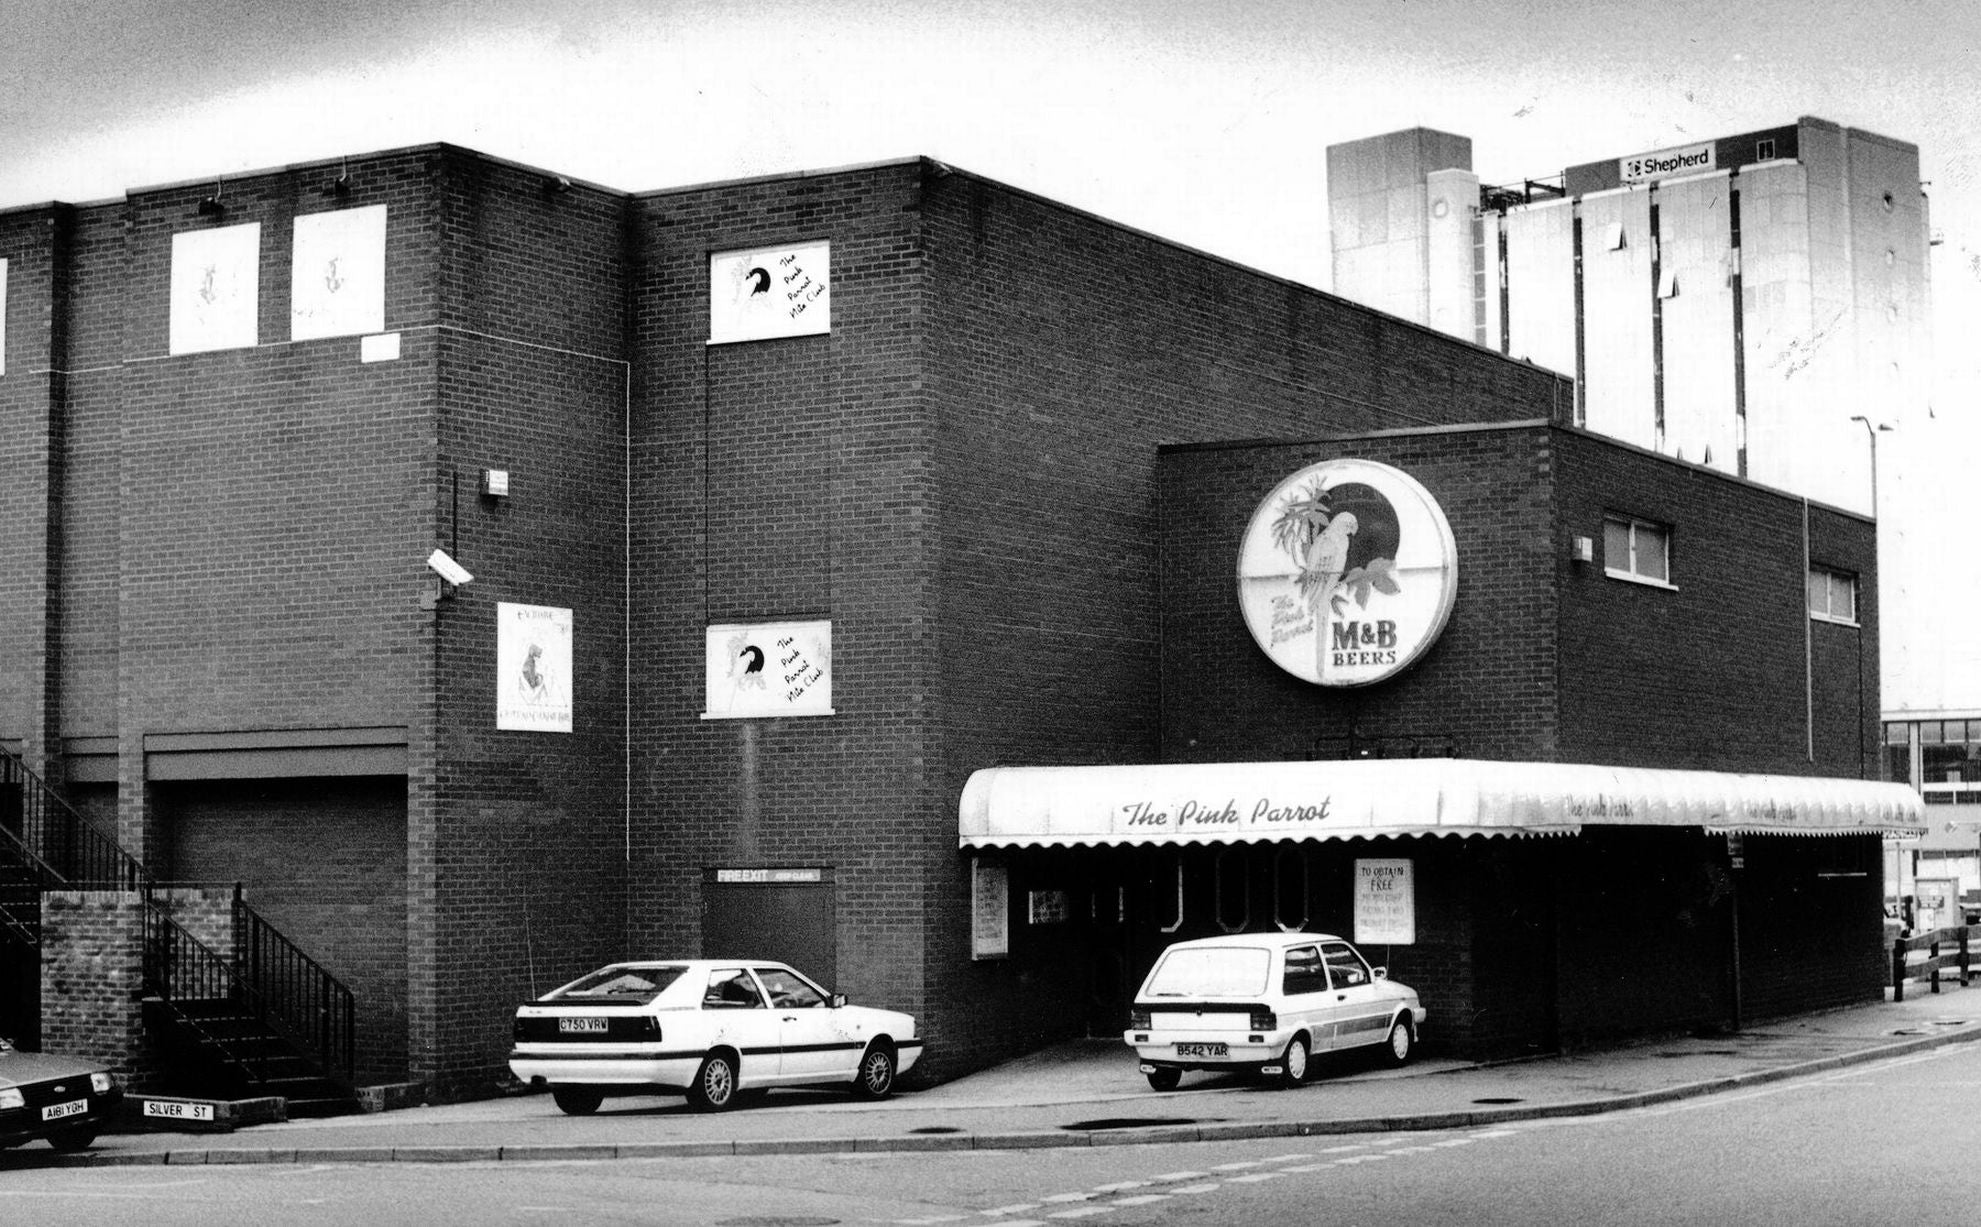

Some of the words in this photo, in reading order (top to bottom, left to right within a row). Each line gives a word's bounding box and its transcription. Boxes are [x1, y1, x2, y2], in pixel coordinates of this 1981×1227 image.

[1644, 149, 1709, 175] Shepherd
[779, 254, 796, 267] The
[783, 266, 803, 285] Pink
[787, 276, 812, 301] Parrot
[806, 283, 826, 302] Club
[777, 637, 794, 649] The
[1332, 619, 1397, 651] M&B
[781, 649, 801, 668] Pink
[1333, 651, 1397, 667] BEERS
[784, 660, 810, 684] Parrot
[803, 667, 824, 687] Club
[1122, 801, 1168, 826] The
[1178, 798, 1239, 826] Pink
[1251, 795, 1331, 825] Parrot
[717, 869, 742, 882] FIRE
[742, 869, 769, 882] EXIT
[1373, 866, 1404, 878] OBTAIN
[1370, 879, 1393, 892] FREE
[588, 1018, 609, 1031] VRW
[1177, 1045, 1205, 1057] B542
[1207, 1045, 1229, 1057] YAR
[149, 1102, 183, 1117] SILVER
[193, 1106, 207, 1118] ST
